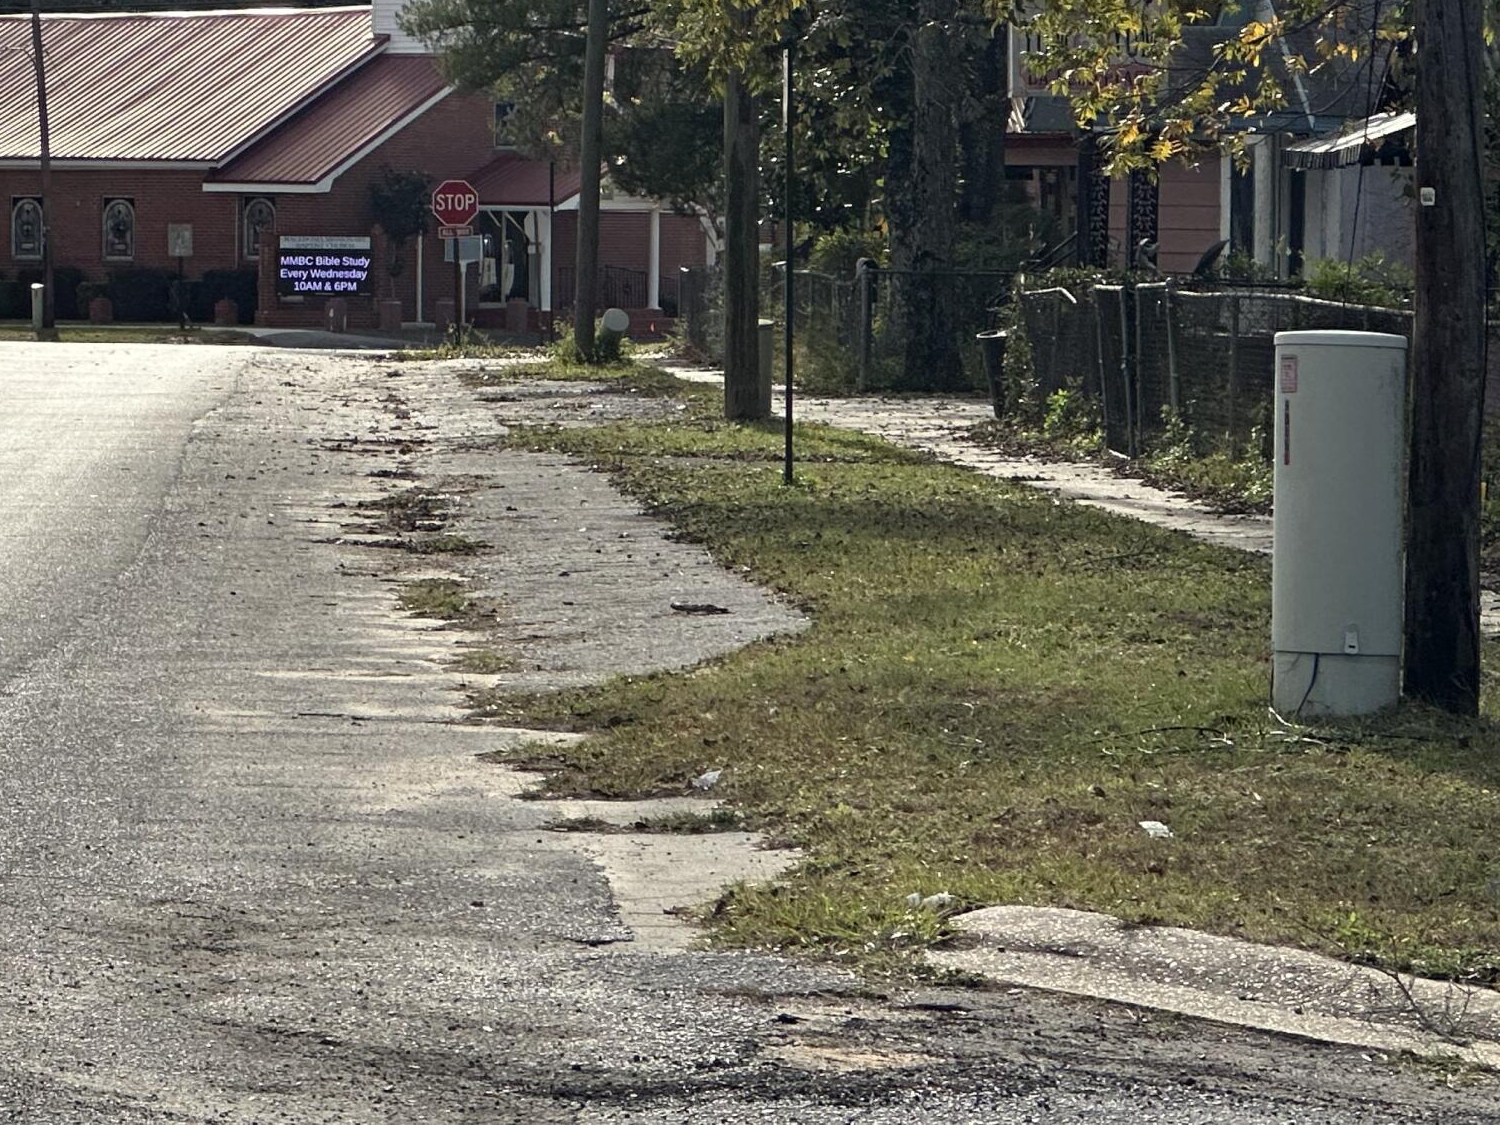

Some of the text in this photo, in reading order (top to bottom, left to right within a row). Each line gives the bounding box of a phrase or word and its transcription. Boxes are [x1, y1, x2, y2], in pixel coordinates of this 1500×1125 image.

[436, 193, 475, 211] STOP
[280, 256, 371, 268] MMBC Bible Study
[280, 268, 368, 281] Every Wednesday
[294, 281, 357, 291] 10AM & 6PM
